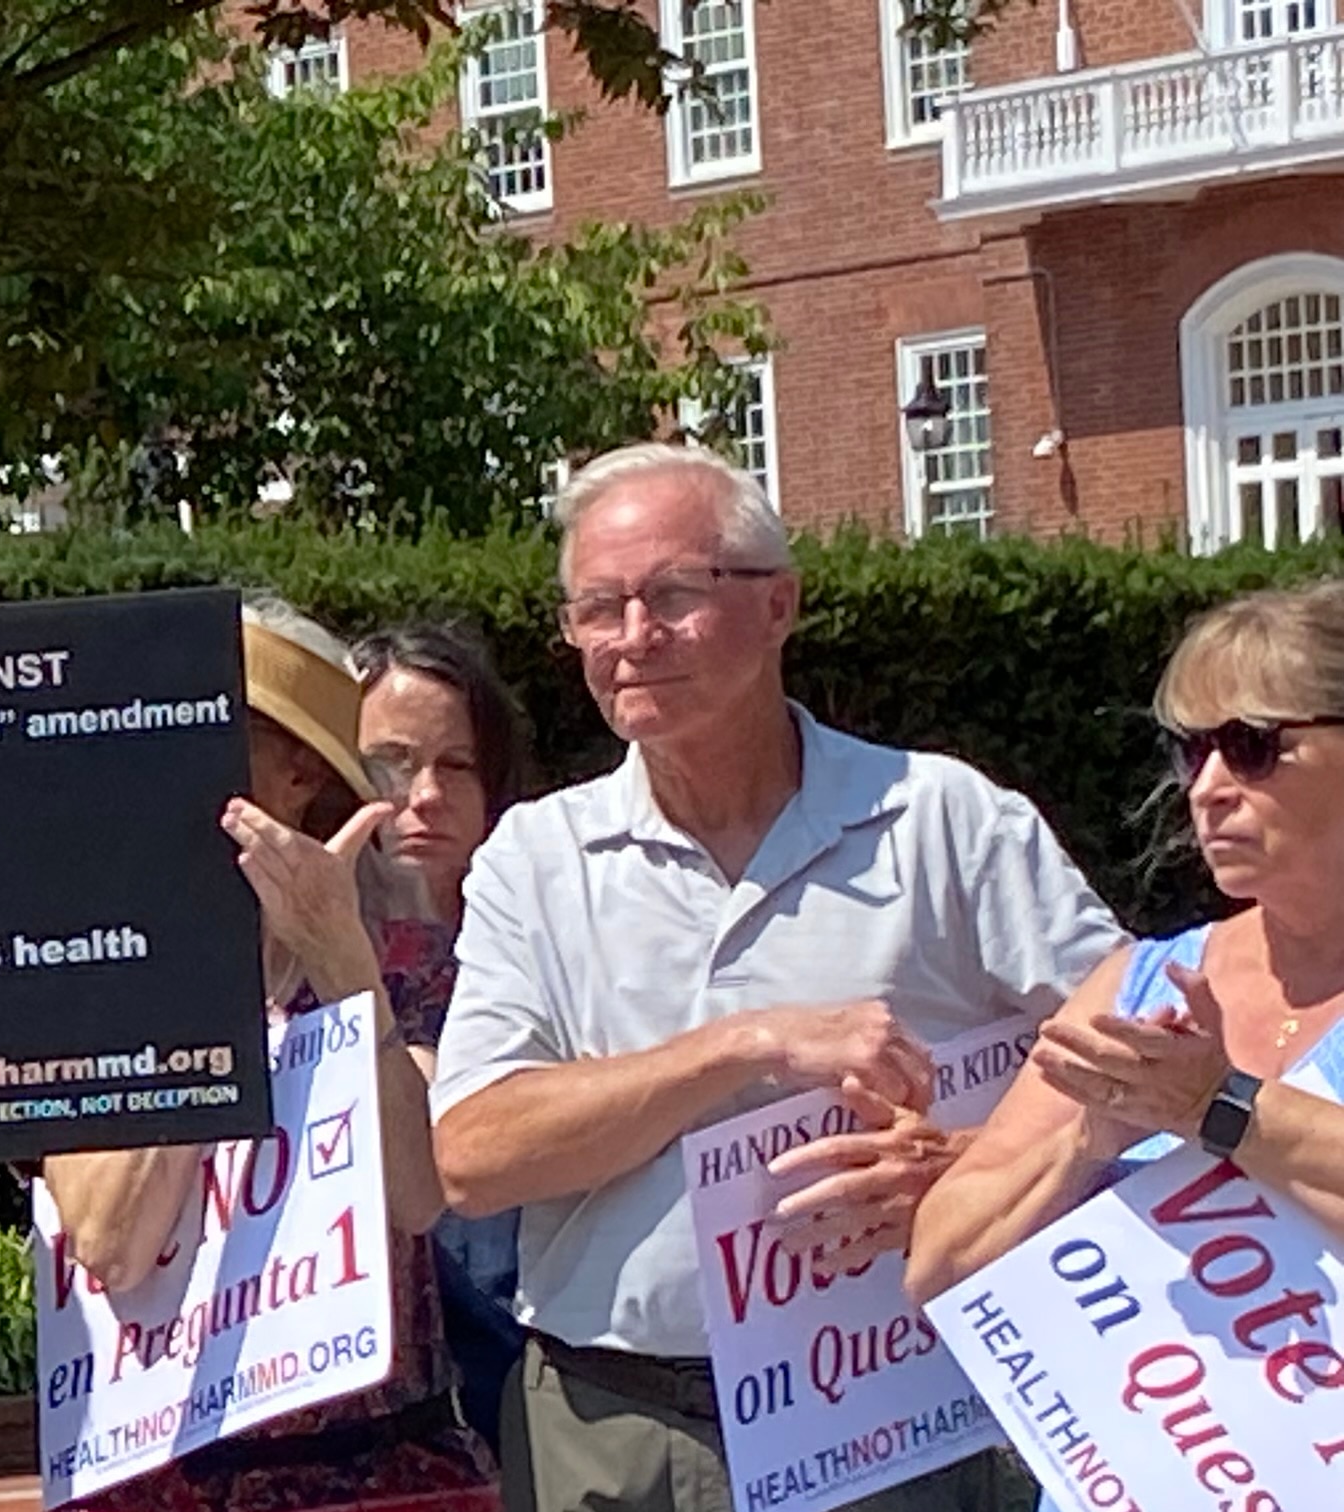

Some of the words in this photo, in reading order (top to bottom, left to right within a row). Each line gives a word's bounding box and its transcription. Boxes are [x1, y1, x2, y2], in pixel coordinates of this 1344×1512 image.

[26, 692, 232, 739] amendment
[13, 925, 148, 967] health
[80, 1094, 124, 1115] NOT
[127, 1084, 239, 1111] DECEPTION
[202, 1126, 291, 1246] NO
[697, 1112, 811, 1189] HANDS
[47, 1353, 95, 1410] en
[108, 1250, 320, 1385] Pregunta
[326, 1205, 371, 1289] 1
[1048, 1237, 1142, 1339] on
[1150, 1157, 1344, 1404] Vote
[48, 1325, 378, 1483] HEALTHNOTHARMMD.ORG
[733, 1358, 795, 1426] on
